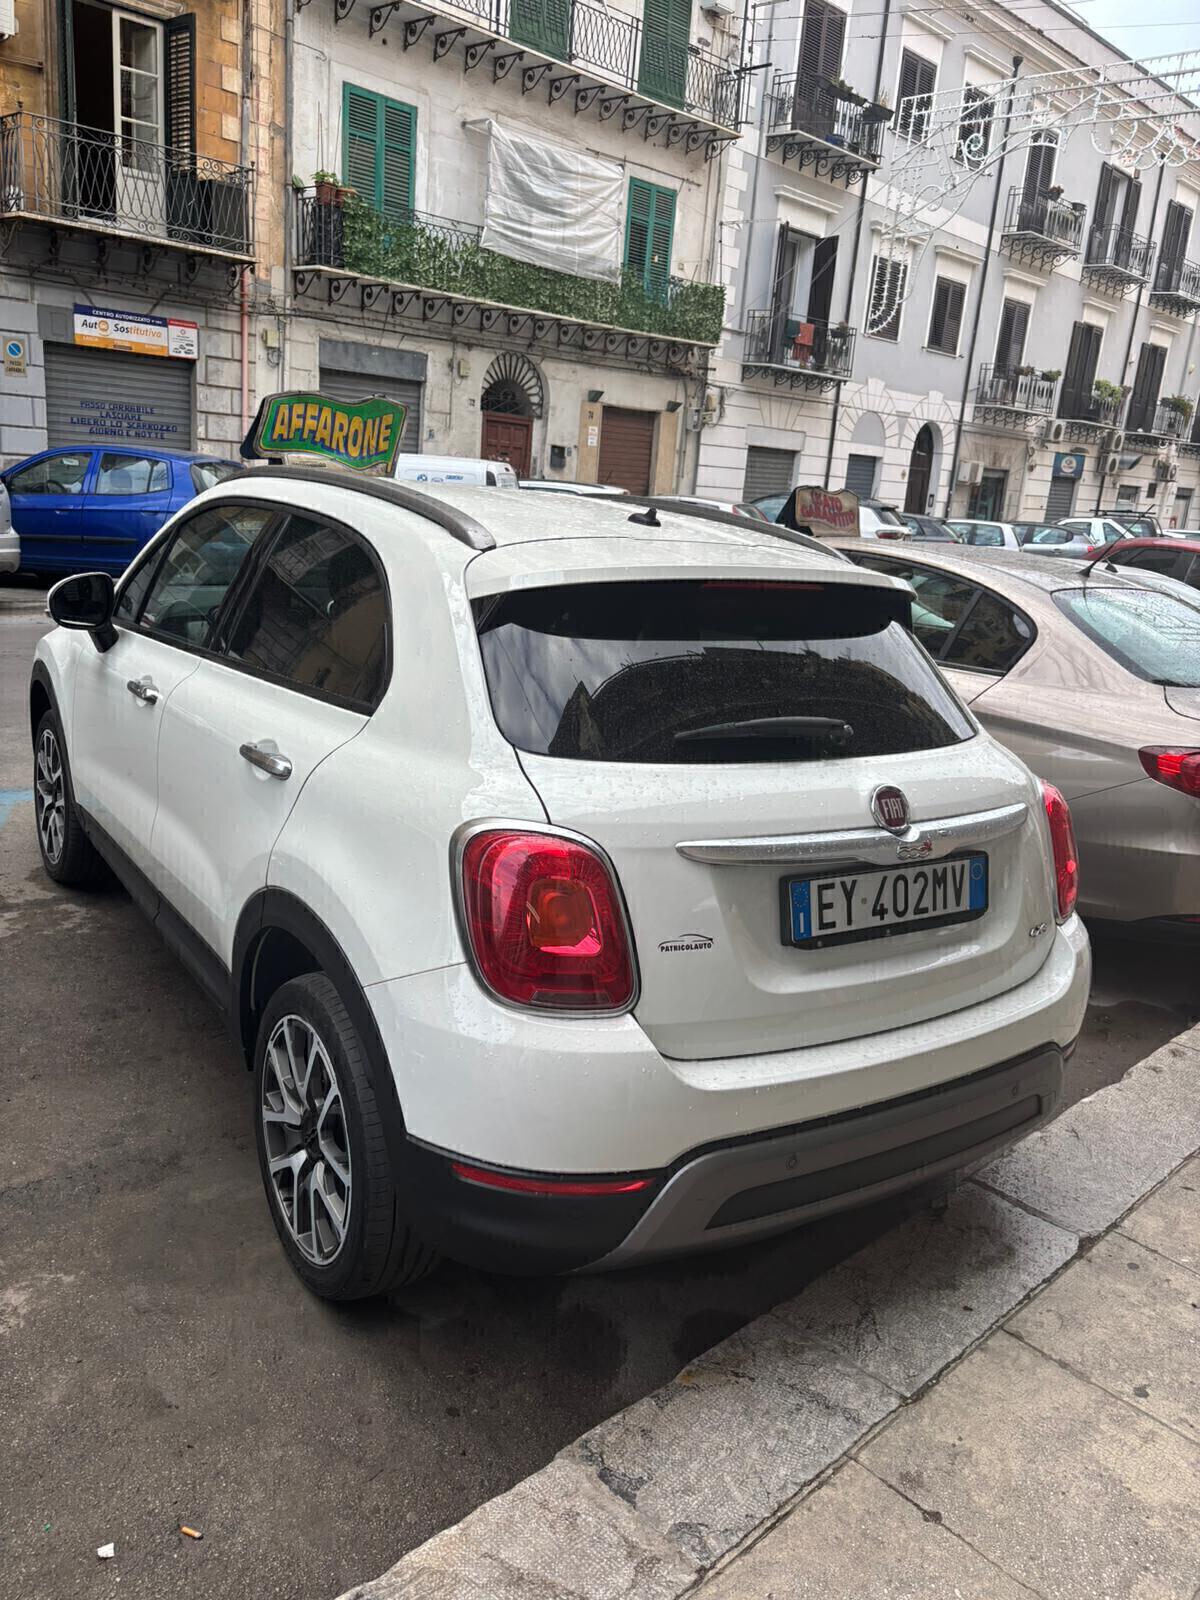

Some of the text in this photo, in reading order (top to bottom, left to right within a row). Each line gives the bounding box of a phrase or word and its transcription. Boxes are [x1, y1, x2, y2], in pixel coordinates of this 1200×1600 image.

[92, 309, 114, 318] CENTRO
[115, 313, 151, 323] AUTORIZZATO
[80, 400, 155, 415] PASSO CARRABILE
[70, 416, 106, 427] LIBERO
[110, 420, 122, 428] LO
[100, 410, 142, 421] LASCIARE
[89, 426, 122, 437] GIORNO
[135, 430, 166, 440] NOTTE
[272, 402, 394, 458] AFFARONE
[881, 798, 905, 819] FIAT
[817, 863, 966, 931] EY 402MV
[660, 942, 712, 952] PATRICOLAUTO
